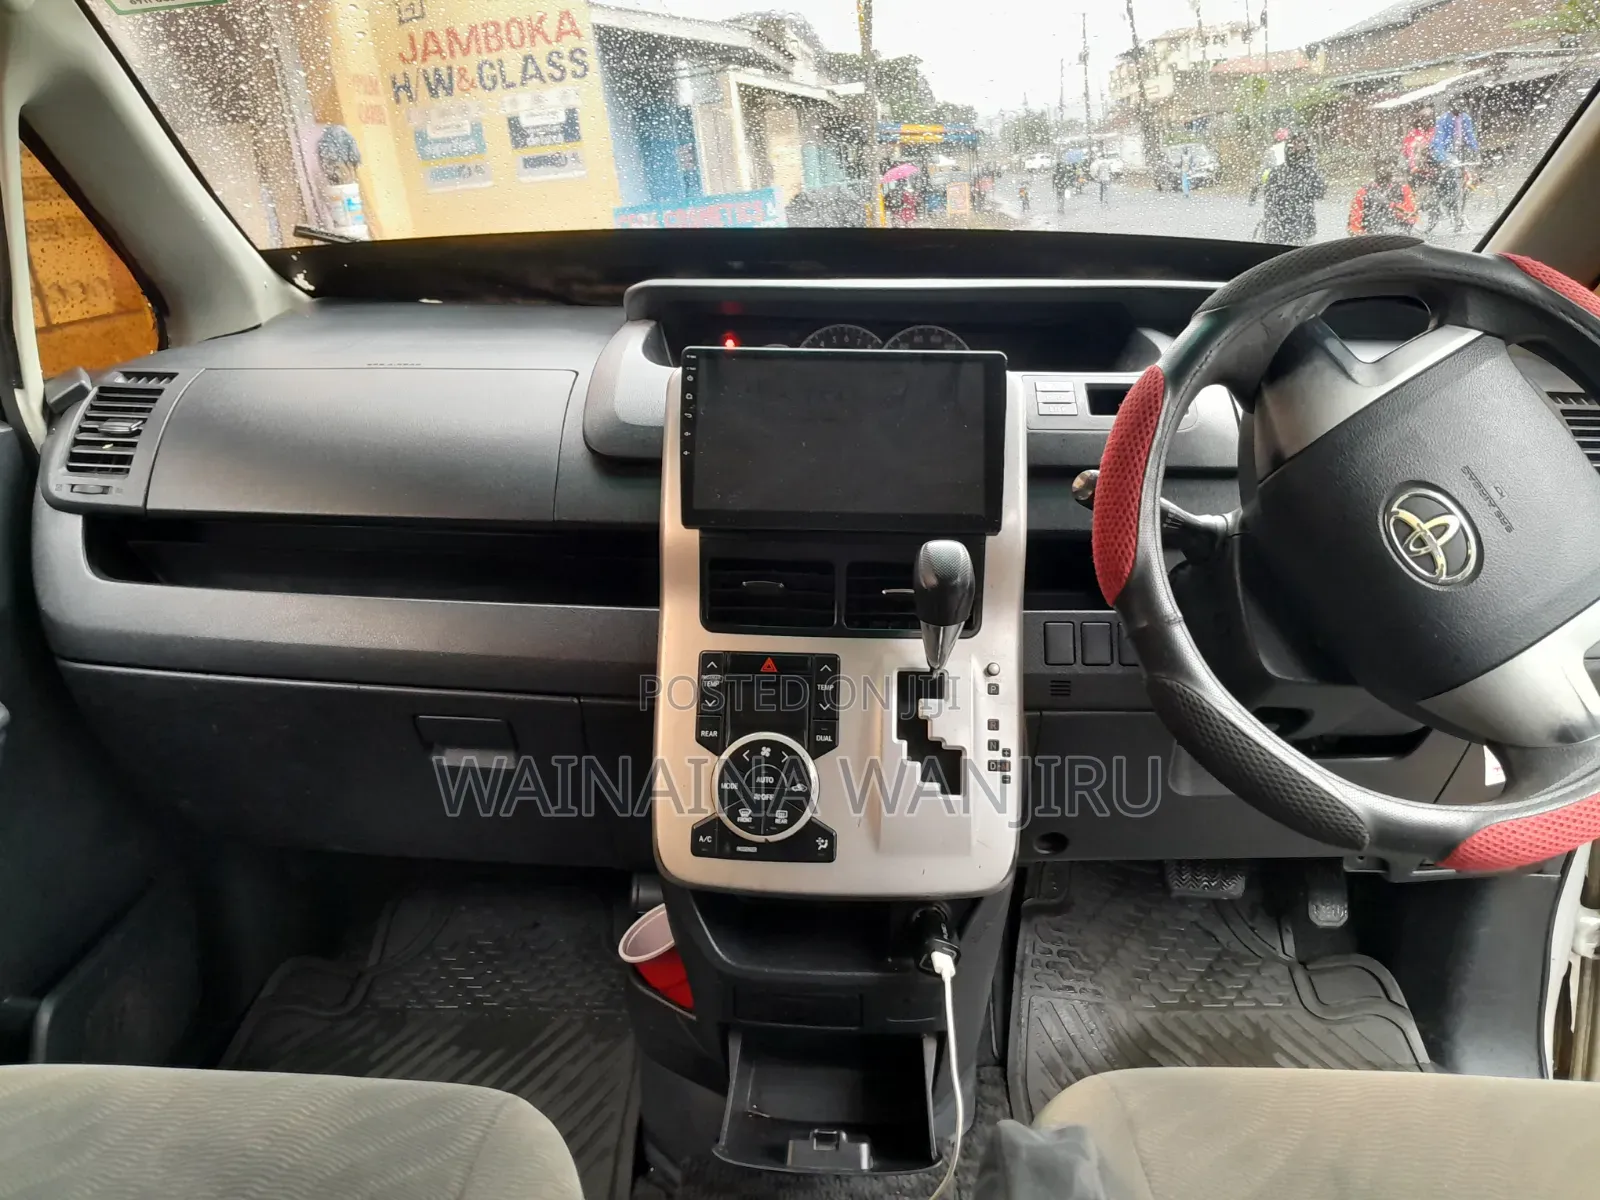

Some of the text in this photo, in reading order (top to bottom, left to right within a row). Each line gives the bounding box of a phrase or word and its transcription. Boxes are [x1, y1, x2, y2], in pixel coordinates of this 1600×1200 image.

[399, 10, 583, 64] JAMBOKA
[990, 685, 997, 694] P
[990, 741, 997, 749] N
[721, 782, 738, 790] MODE
